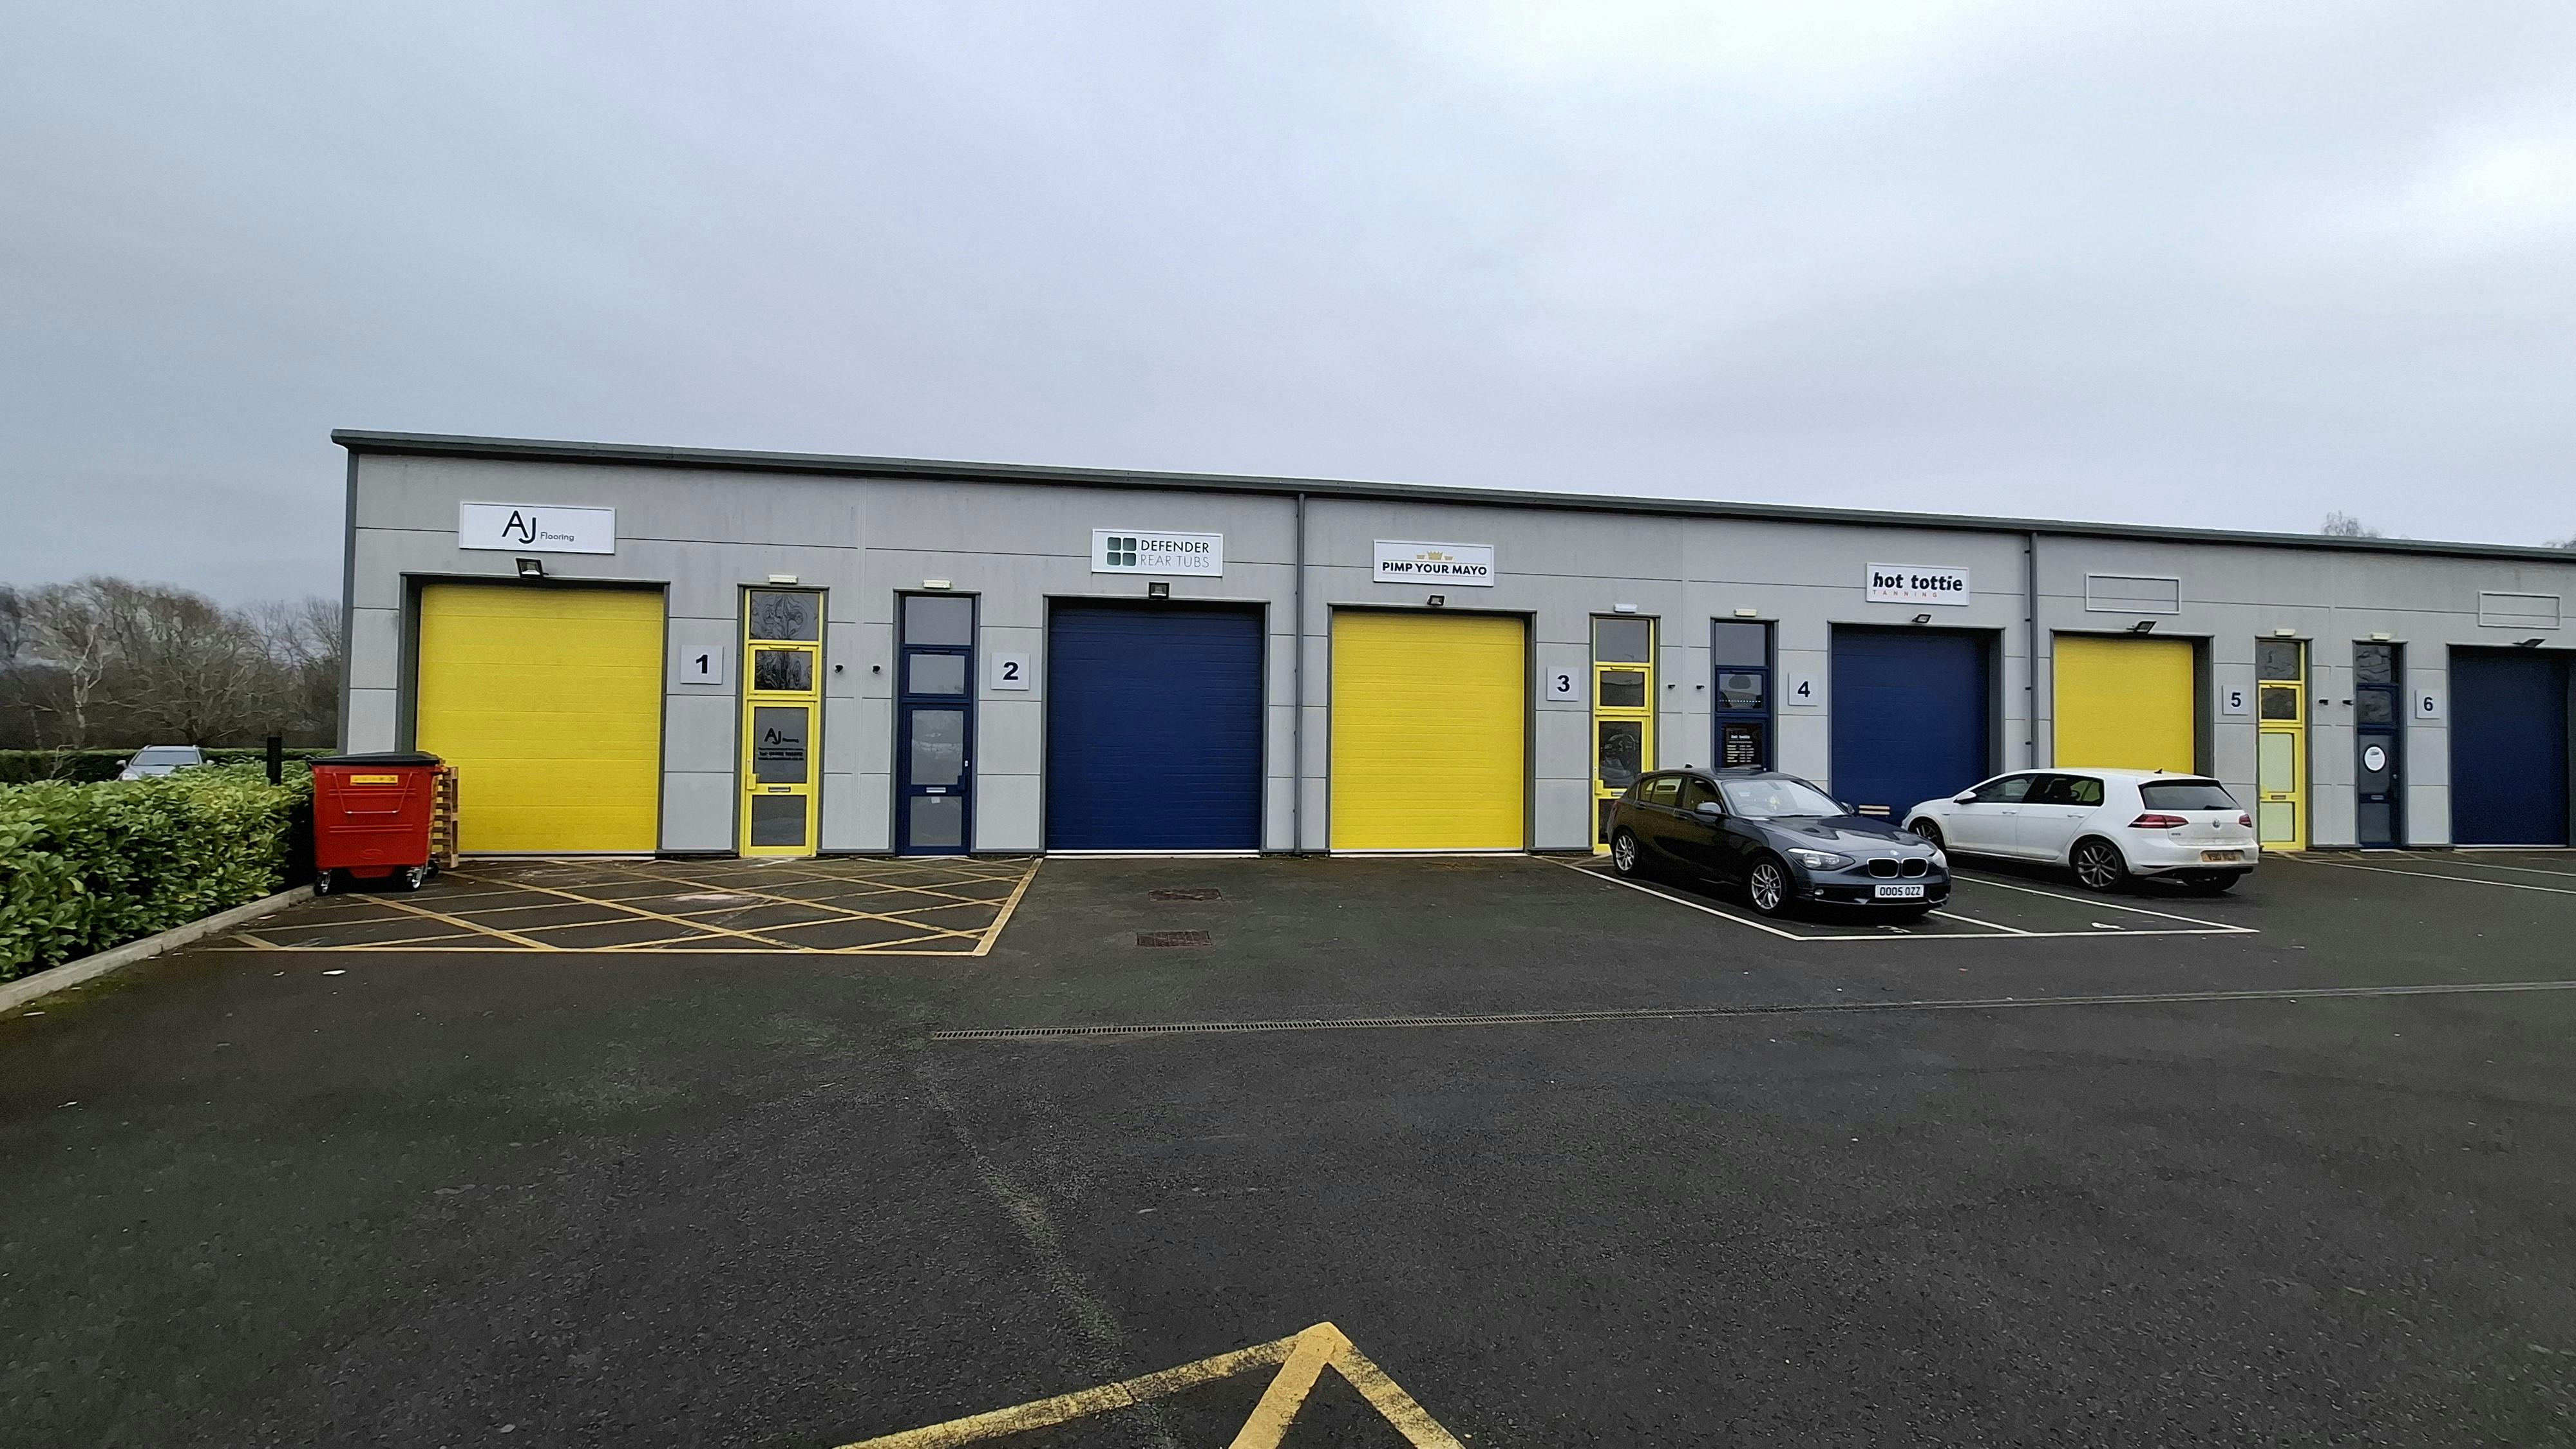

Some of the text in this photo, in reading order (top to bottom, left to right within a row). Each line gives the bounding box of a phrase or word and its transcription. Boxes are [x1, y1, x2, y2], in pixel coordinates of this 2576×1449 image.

[502, 510, 574, 544] AJ Flooring
[1141, 540, 1209, 553] DEFENDER
[1141, 554, 1209, 568] REAR TUBS
[1382, 562, 1487, 576] PIMP YOUR MAYO
[1873, 572, 1963, 591] hot tottie
[696, 654, 708, 674] 1
[1003, 661, 1019, 681] 2
[1557, 675, 1570, 693] 3
[1797, 681, 1811, 698] 4
[2231, 692, 2242, 708] 5
[2423, 696, 2434, 712] 6
[764, 727, 782, 745] AJ
